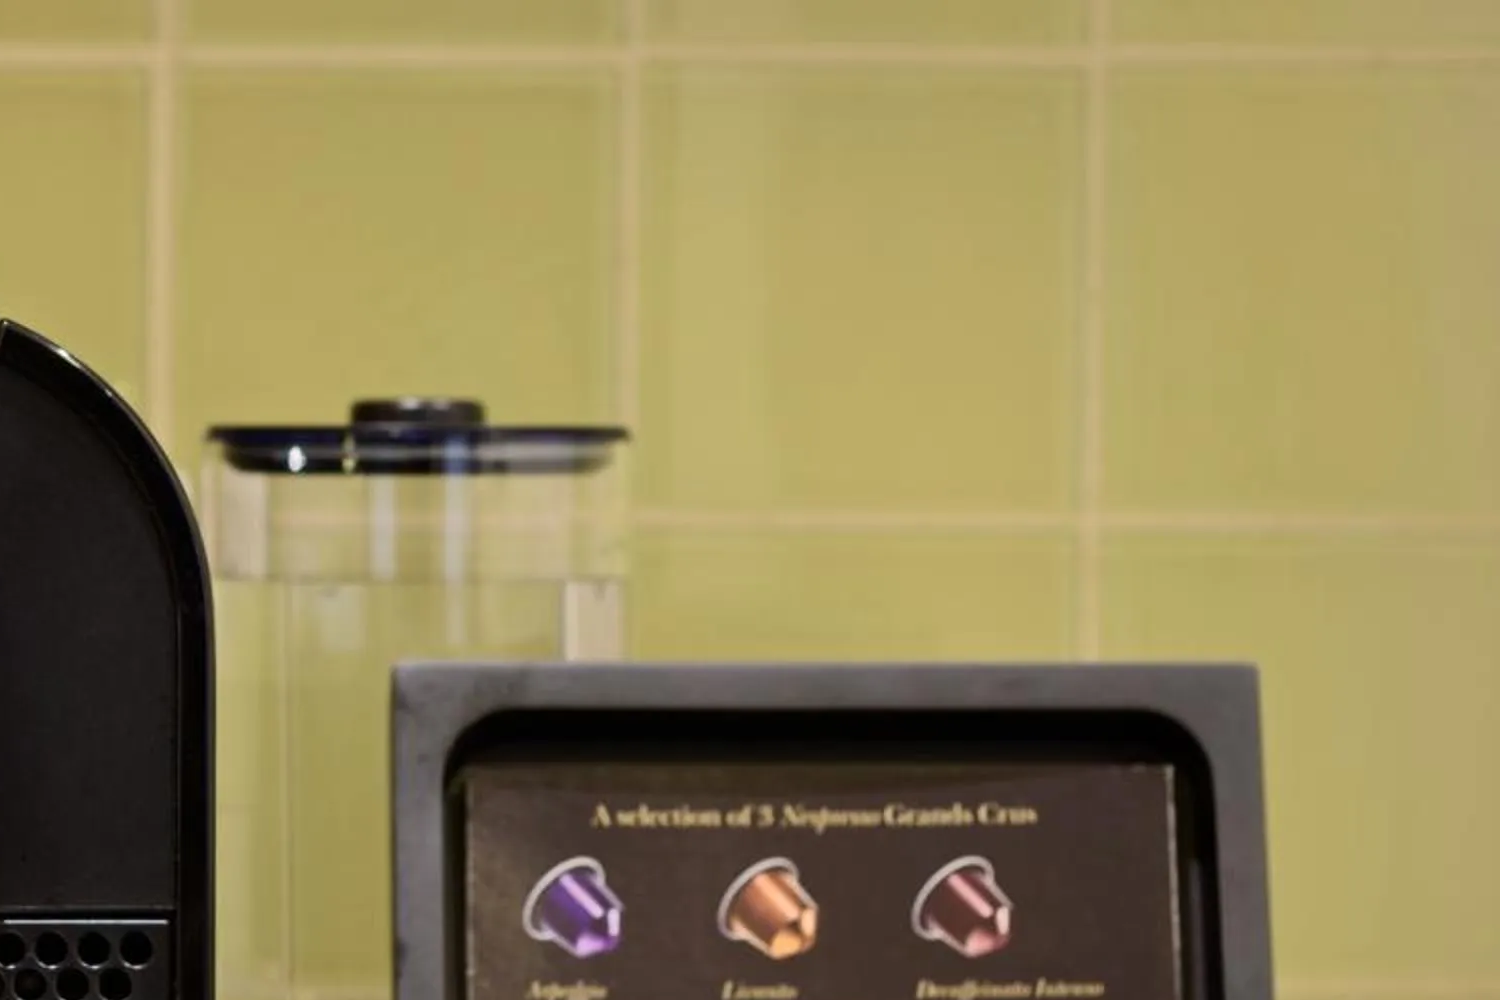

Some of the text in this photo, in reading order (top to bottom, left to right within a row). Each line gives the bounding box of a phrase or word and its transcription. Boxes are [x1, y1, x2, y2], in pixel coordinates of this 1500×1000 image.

[593, 804, 611, 826] A
[616, 804, 721, 827] selection
[726, 805, 752, 827] of
